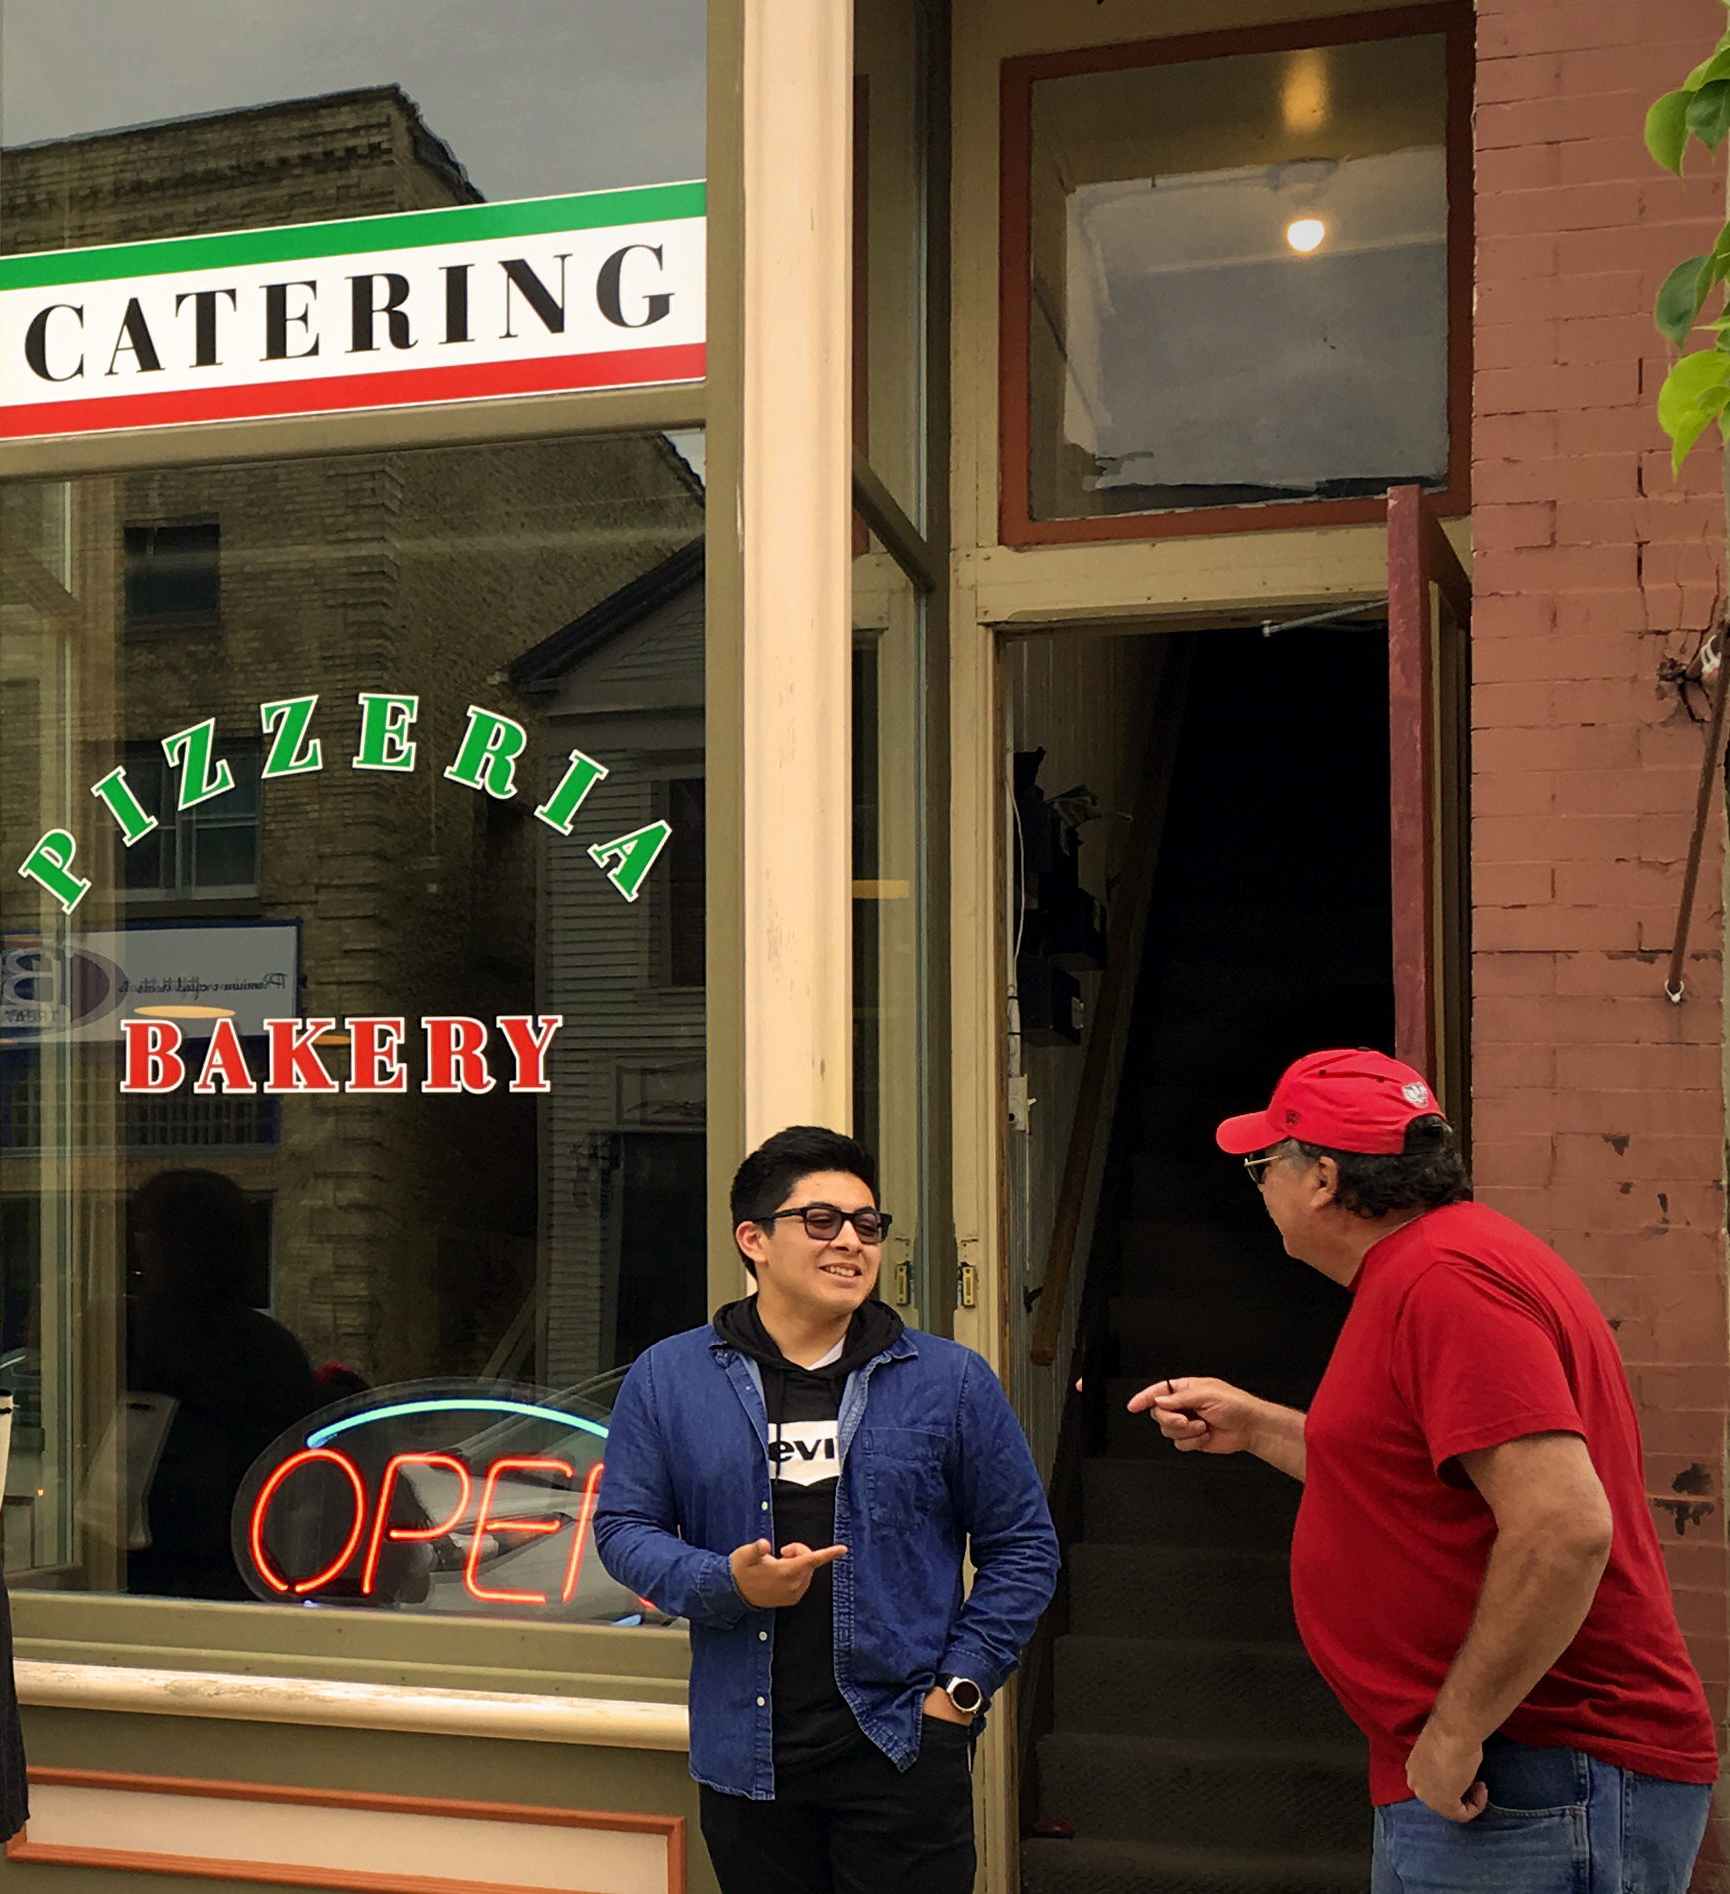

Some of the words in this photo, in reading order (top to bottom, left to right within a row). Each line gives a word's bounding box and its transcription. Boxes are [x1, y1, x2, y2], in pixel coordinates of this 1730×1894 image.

[24, 244, 675, 383] CATERING
[18, 692, 672, 914] PIZZERIA
[120, 1014, 563, 1095] BAKERY
